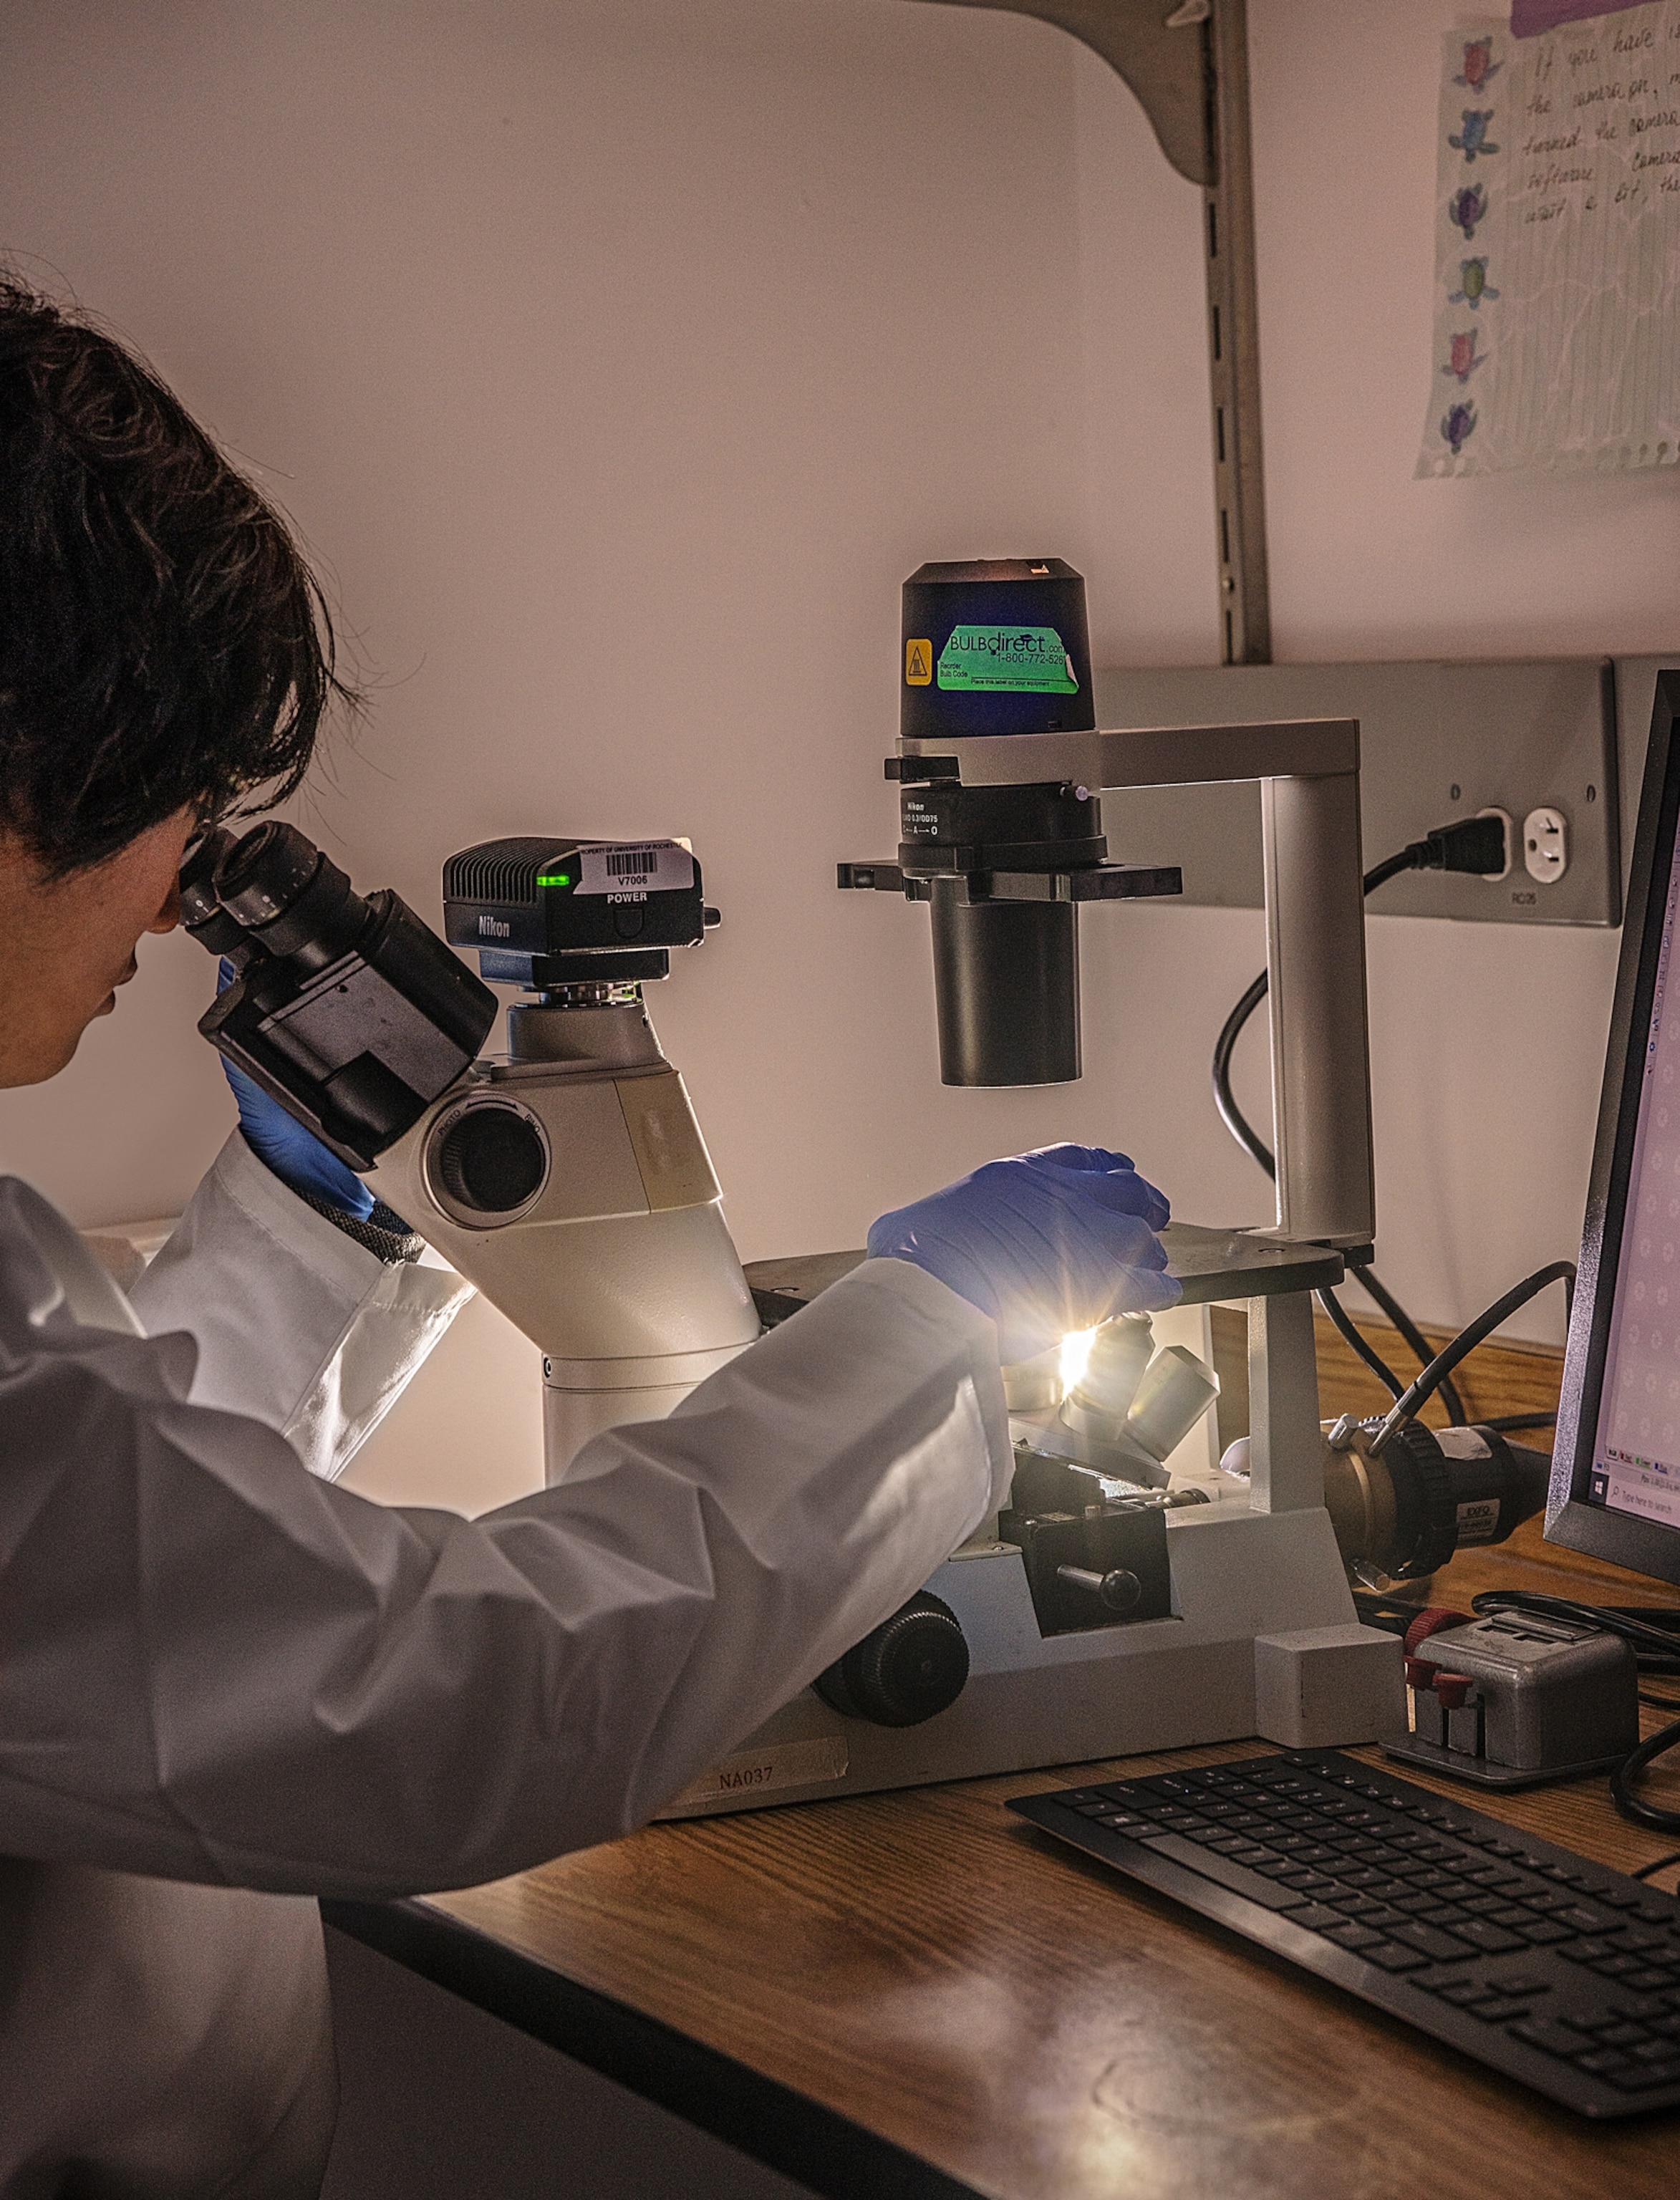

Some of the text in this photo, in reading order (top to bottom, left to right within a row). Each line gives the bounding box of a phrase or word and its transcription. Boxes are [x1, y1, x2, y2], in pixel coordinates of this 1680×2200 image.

[1613, 28, 1654, 53] have
[996, 652, 1066, 665] 1-800-772-526
[618, 875, 648, 887] V7006
[607, 892, 648, 904] POWER
[479, 915, 511, 938] Nikon
[438, 1109, 462, 1137] PHOTO
[719, 1766, 773, 1789] NA037
